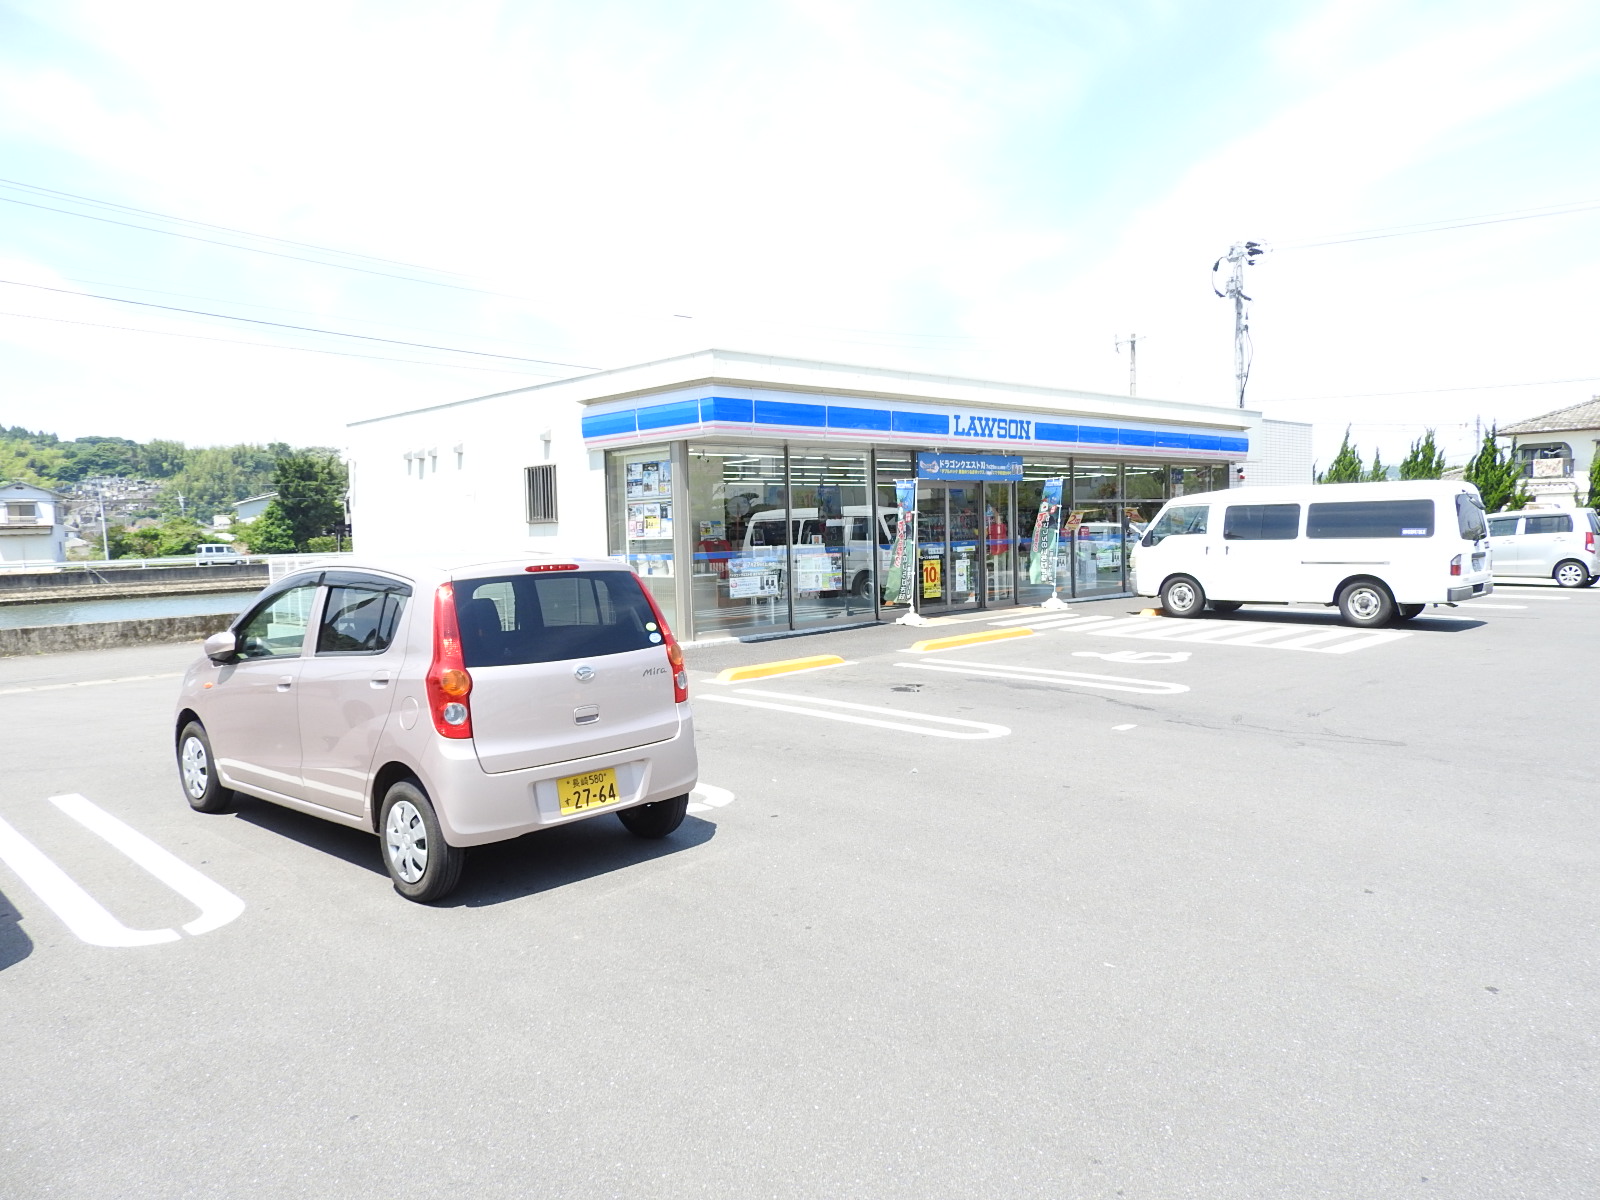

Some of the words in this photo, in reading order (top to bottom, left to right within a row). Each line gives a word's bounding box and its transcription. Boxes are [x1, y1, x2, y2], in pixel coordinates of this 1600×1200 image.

[953, 414, 1032, 440] LAWSON
[642, 667, 667, 677] Mira
[572, 773, 604, 788] 長崎580
[565, 797, 571, 806] す
[573, 783, 616, 808] 27-64
